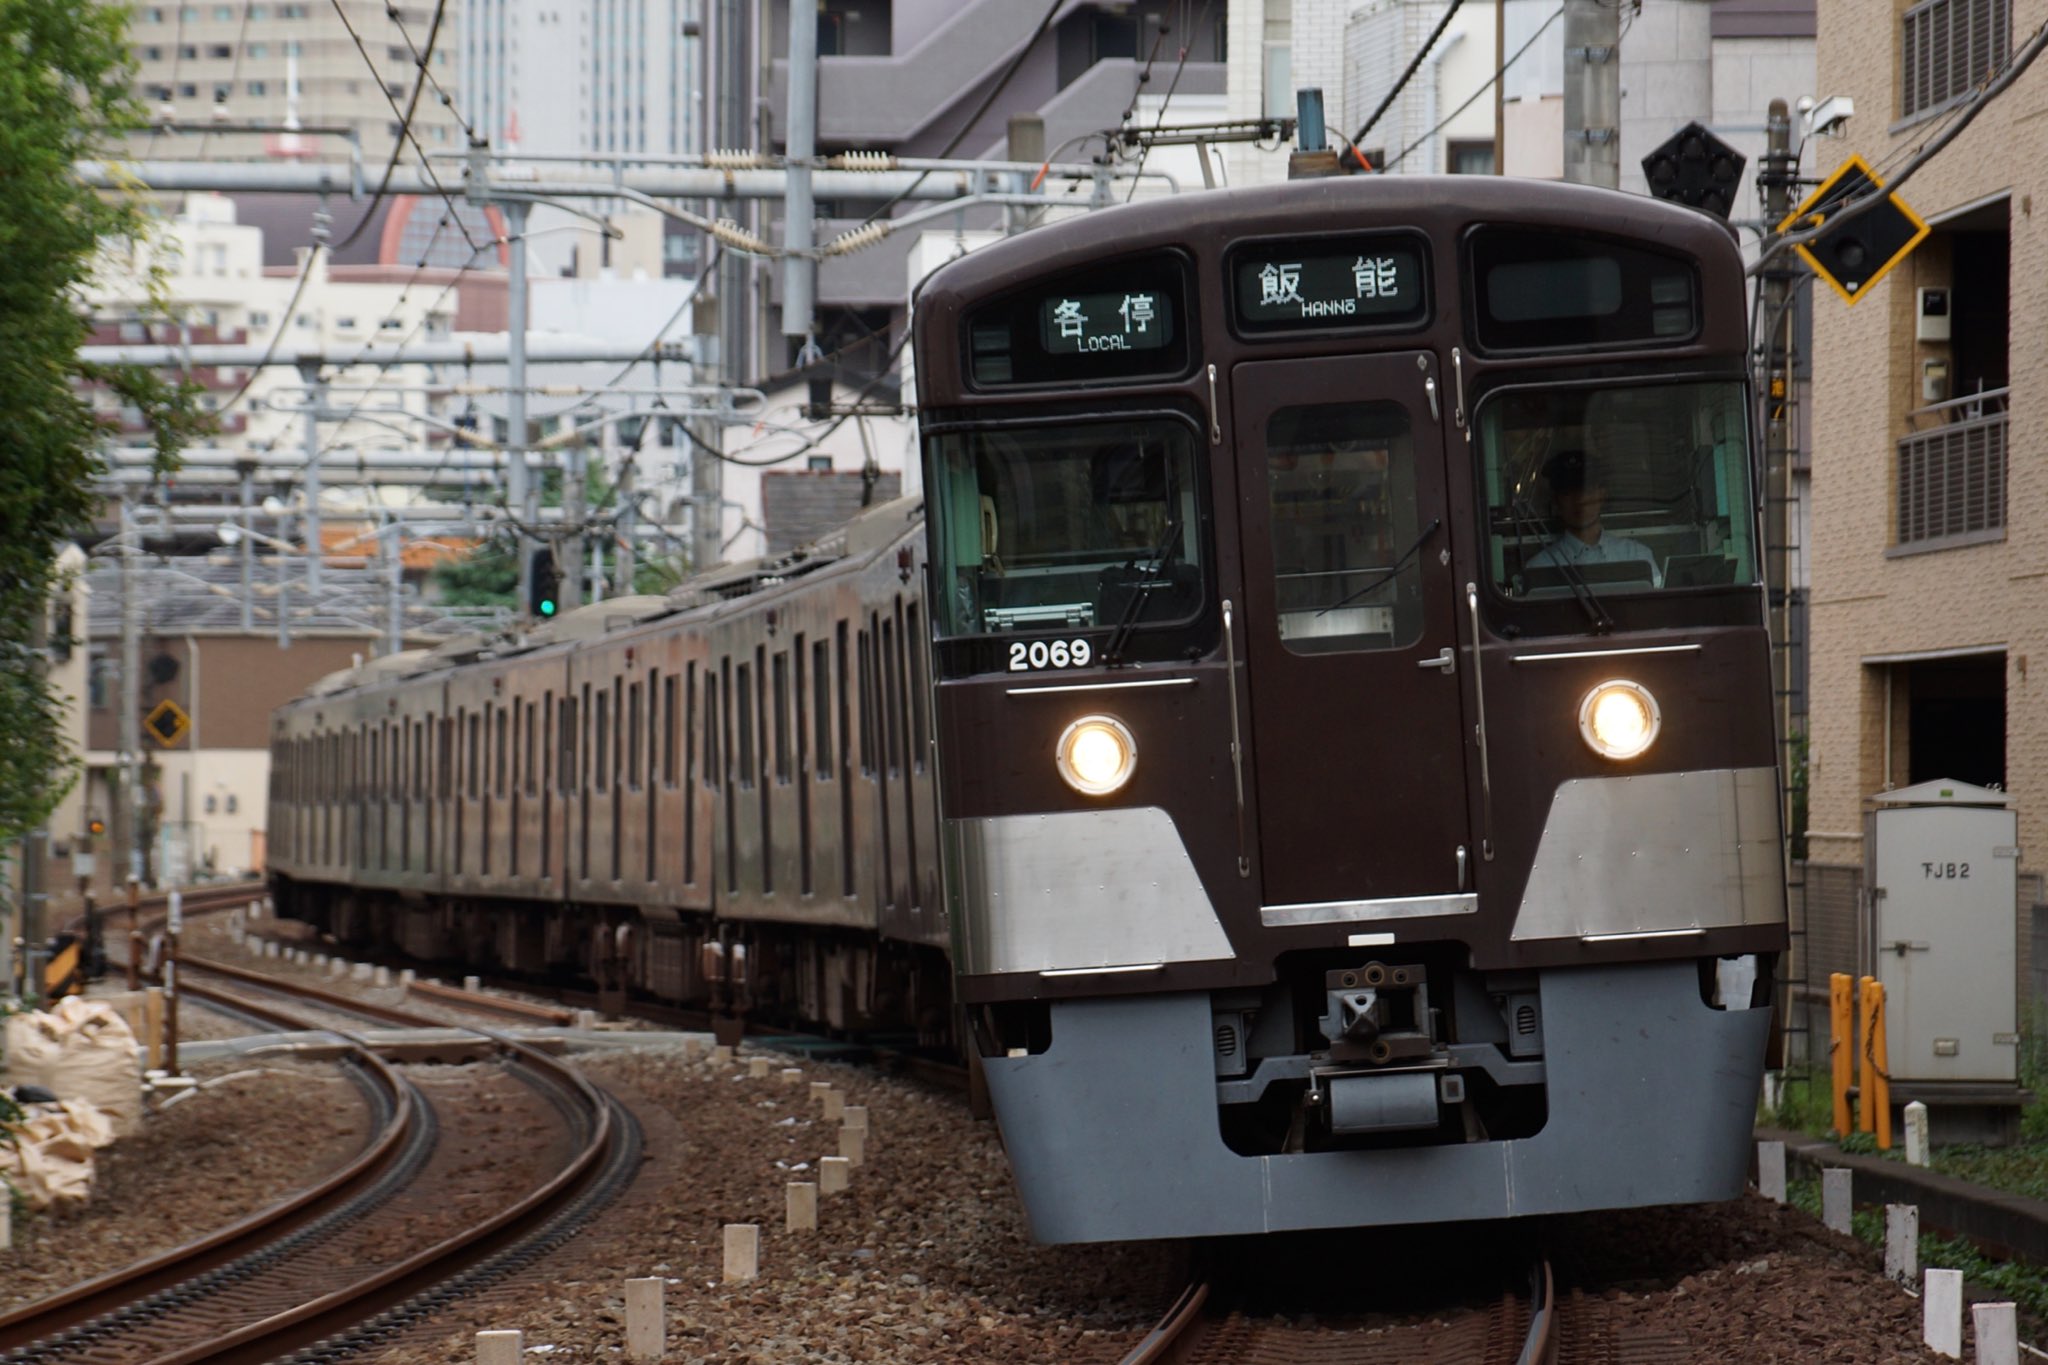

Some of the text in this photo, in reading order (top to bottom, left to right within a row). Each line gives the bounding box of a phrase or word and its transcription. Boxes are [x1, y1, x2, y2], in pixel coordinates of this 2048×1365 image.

[1258, 256, 1398, 306] 飯能
[1053, 294, 1154, 338] 各停
[1077, 335, 1131, 353] LOCAL
[1009, 638, 1091, 671] 2069
